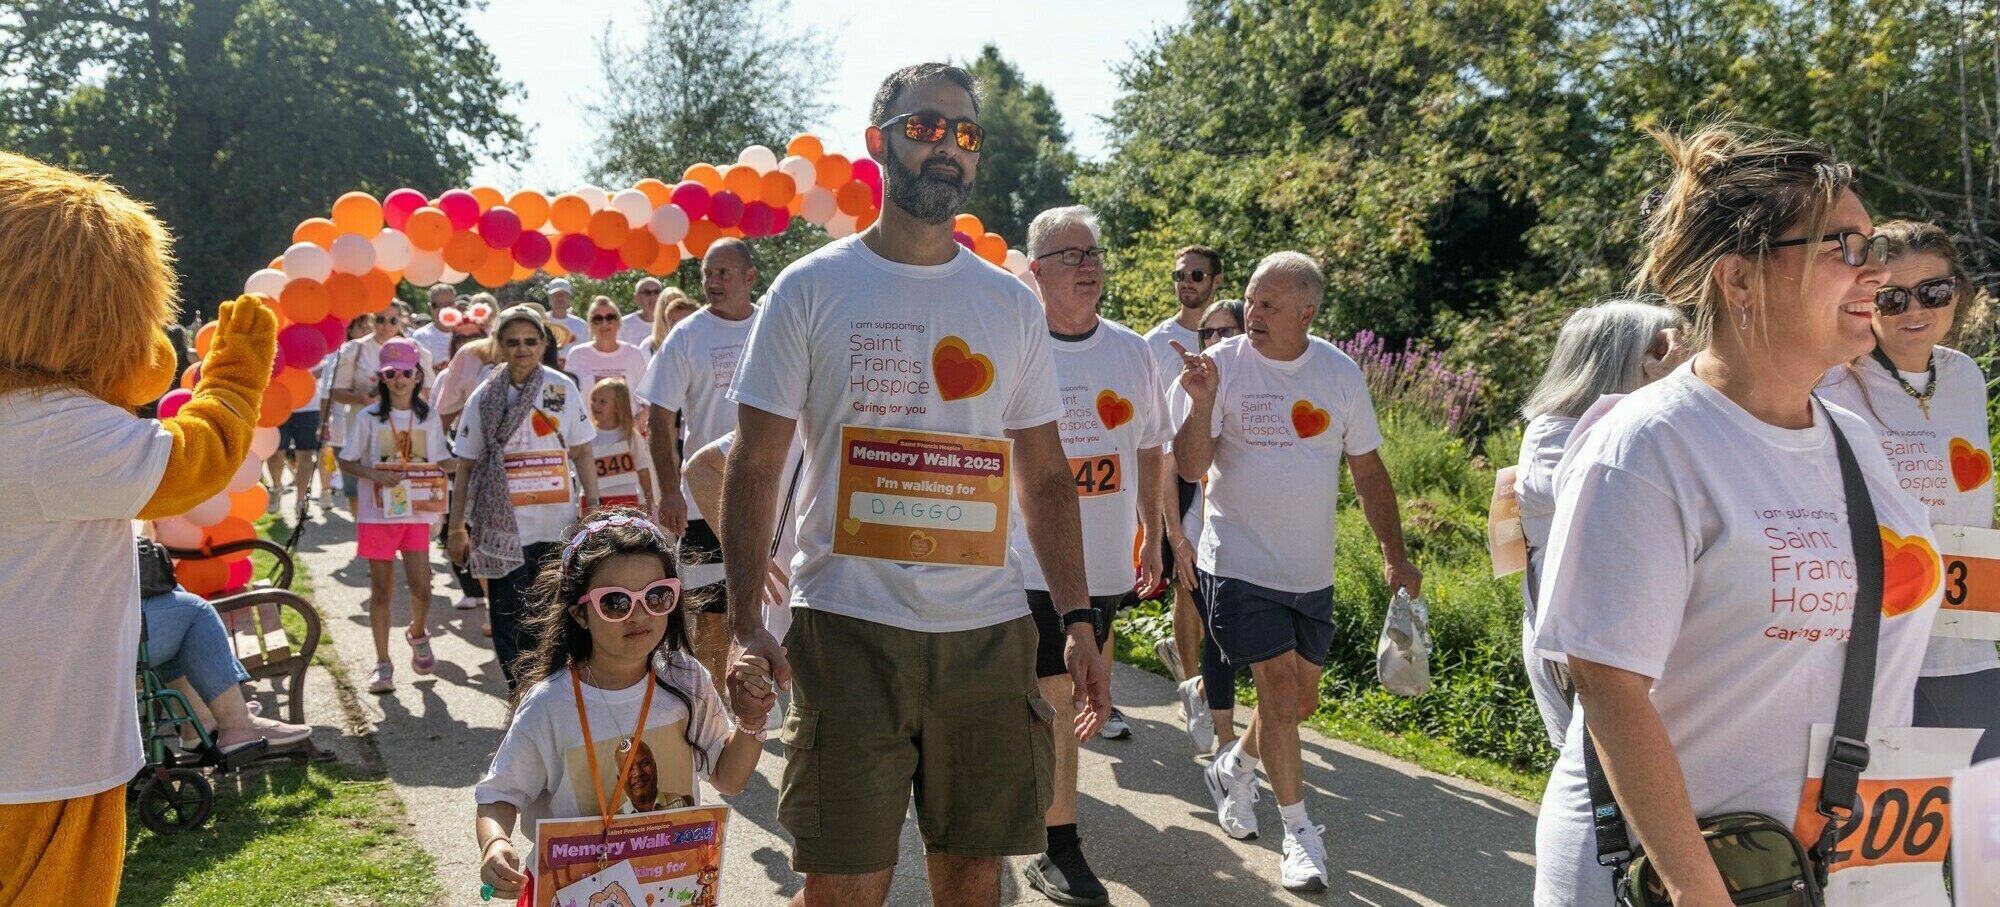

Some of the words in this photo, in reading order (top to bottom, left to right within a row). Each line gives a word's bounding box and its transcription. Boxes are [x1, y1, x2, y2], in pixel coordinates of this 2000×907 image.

[874, 322, 925, 333] supporting
[849, 334, 902, 352] Saint
[850, 354, 922, 374] Francis
[850, 374, 930, 396] Hospice
[852, 401, 886, 415] Caring
[888, 403, 902, 413] for
[905, 405, 927, 415] you
[1062, 394, 1078, 405] int
[1241, 401, 1273, 411] Saint
[1063, 406, 1092, 418] ancis
[1059, 419, 1098, 431] ospice
[917, 442, 939, 450] Francis
[939, 444, 961, 452] Hospice
[1881, 440, 1929, 456] Saint
[595, 454, 634, 477] 340
[852, 446, 920, 466] Memory
[923, 452, 962, 468] Walk
[963, 456, 1001, 471] 2025
[876, 476, 899, 489] I'm
[902, 479, 954, 495] walking
[957, 483, 977, 496] for
[1899, 473, 1948, 491] ospice
[872, 498, 962, 521] DAGGO
[1764, 526, 1838, 551] Saint
[623, 827, 646, 835] Francis
[646, 823, 671, 831] Hospice
[552, 840, 627, 858] Memory
[629, 832, 671, 851] Walk
[666, 861, 687, 874] for
